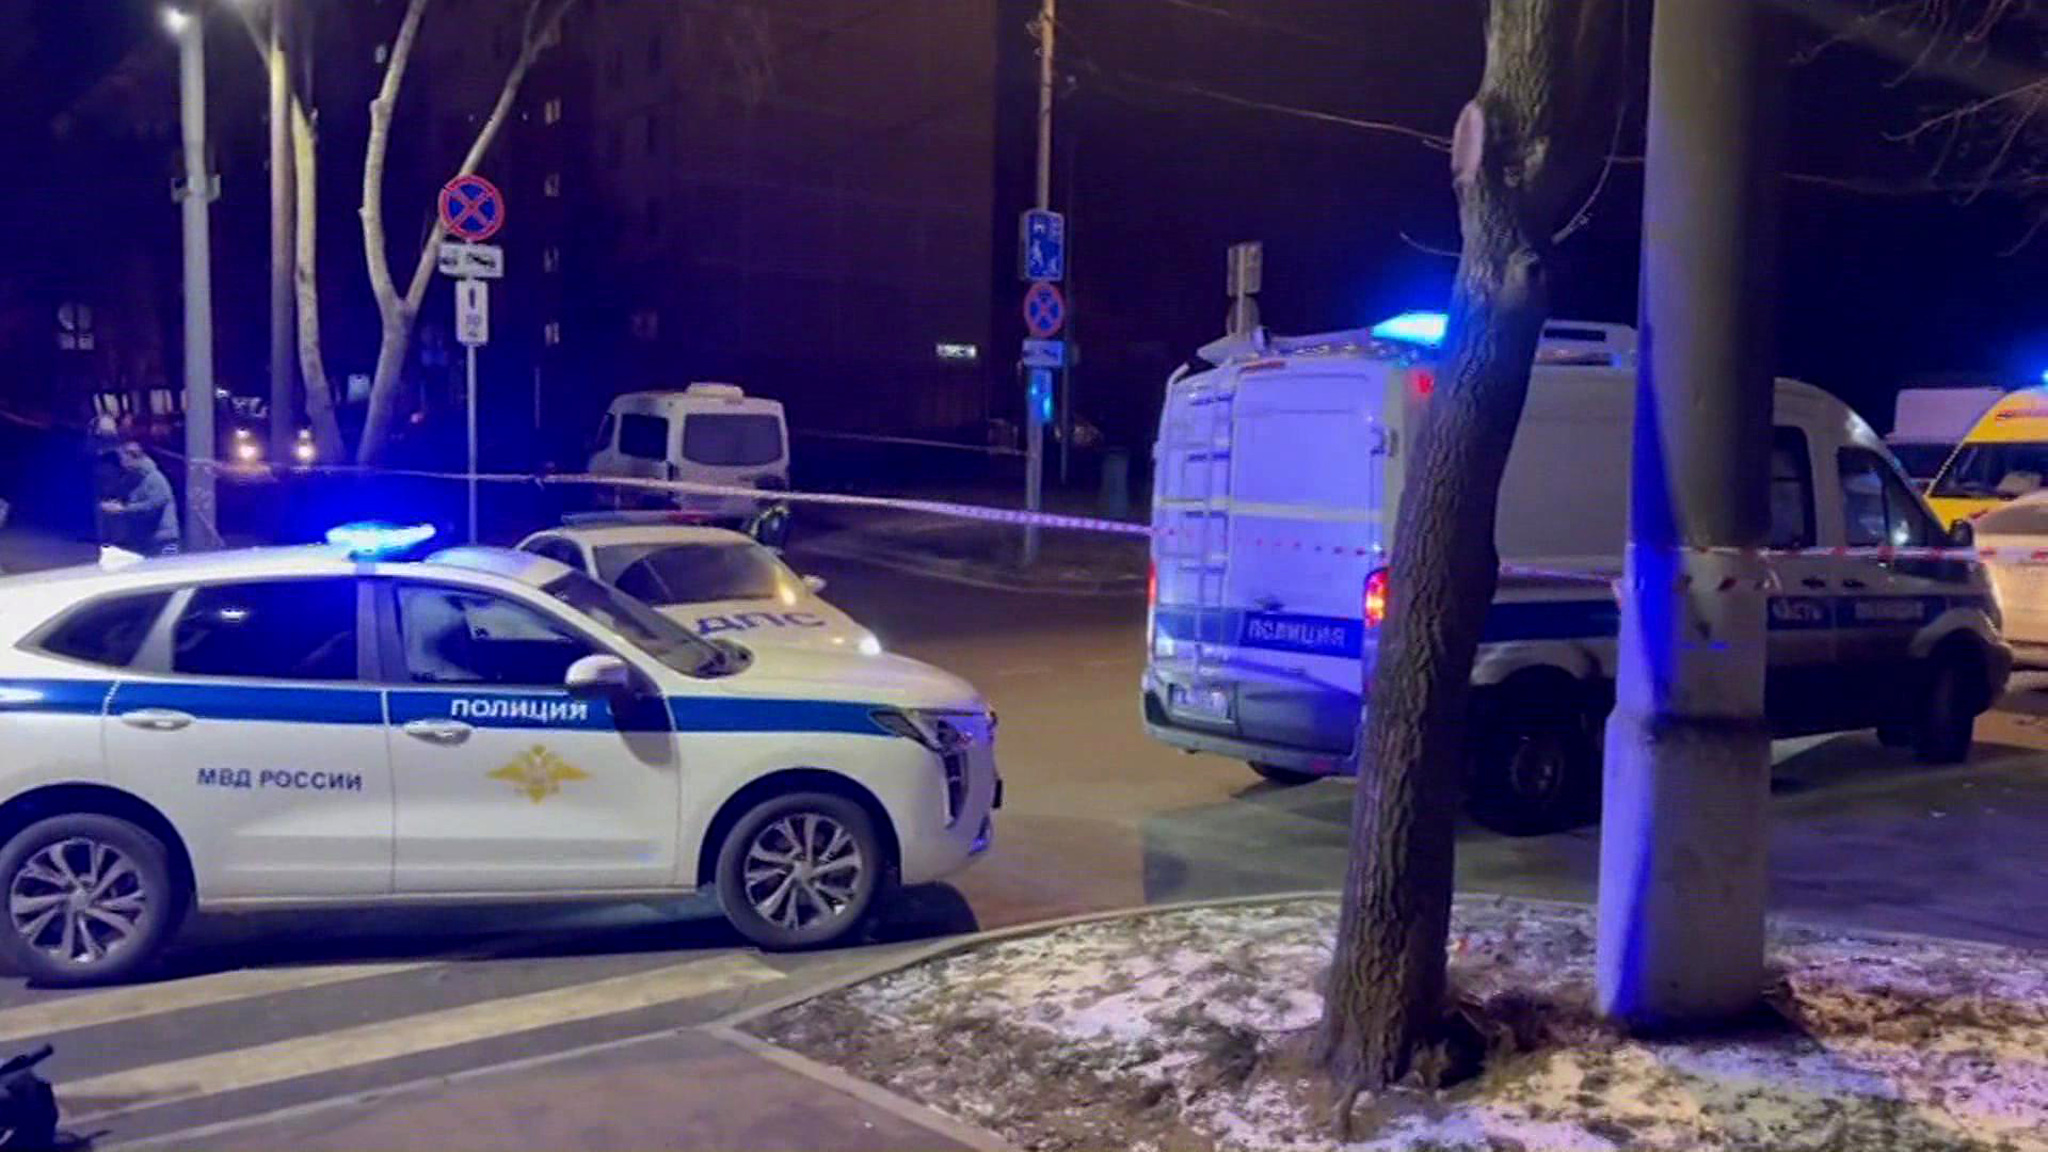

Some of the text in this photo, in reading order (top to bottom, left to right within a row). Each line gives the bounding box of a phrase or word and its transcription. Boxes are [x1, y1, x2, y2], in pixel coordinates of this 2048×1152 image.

[698, 612, 825, 635] ДПС
[452, 699, 588, 723] ПОЛИЦИЯ
[197, 767, 362, 791] МВД РОССИИ
